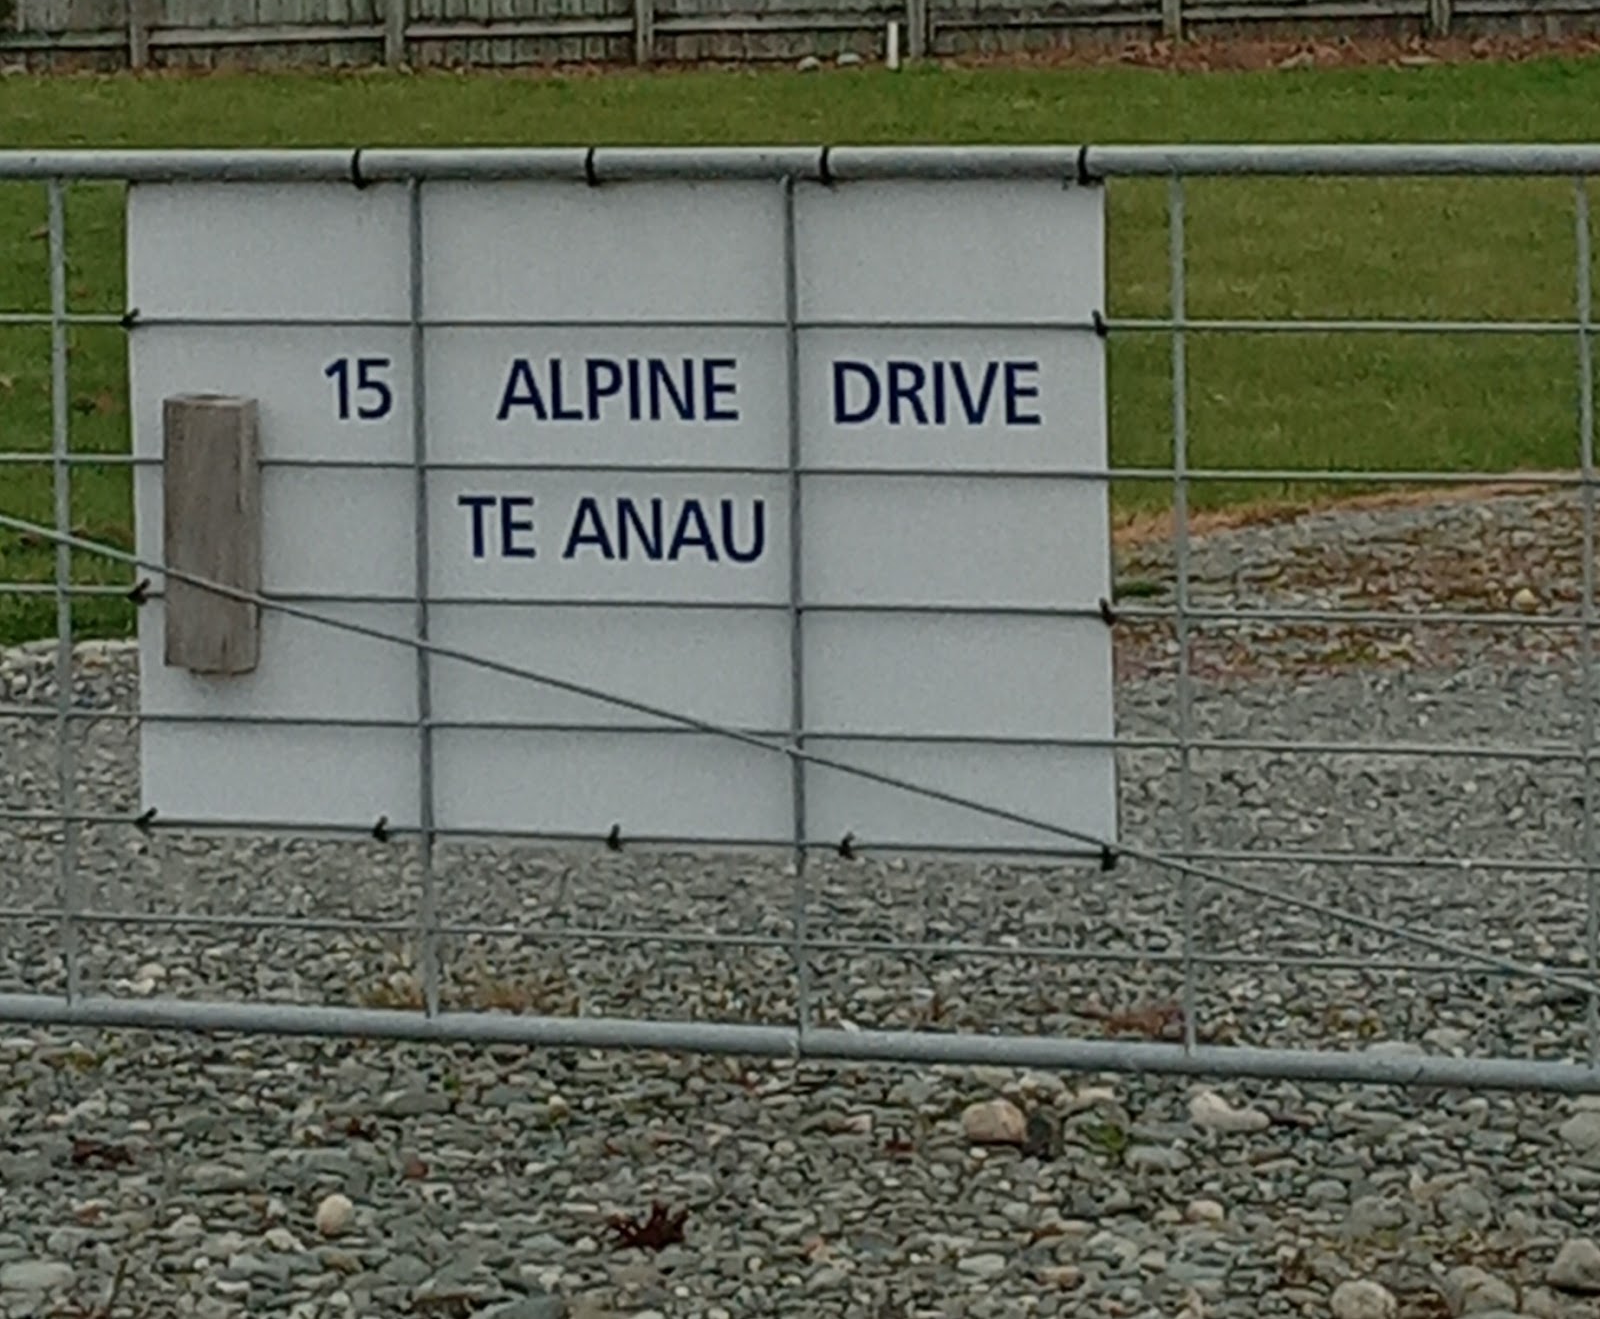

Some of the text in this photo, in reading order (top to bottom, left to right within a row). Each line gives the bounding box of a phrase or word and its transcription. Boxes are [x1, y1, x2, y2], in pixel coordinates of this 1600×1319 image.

[324, 357, 1042, 426] 15 ALPINE DRIVE
[457, 494, 765, 564] TE ANAU
